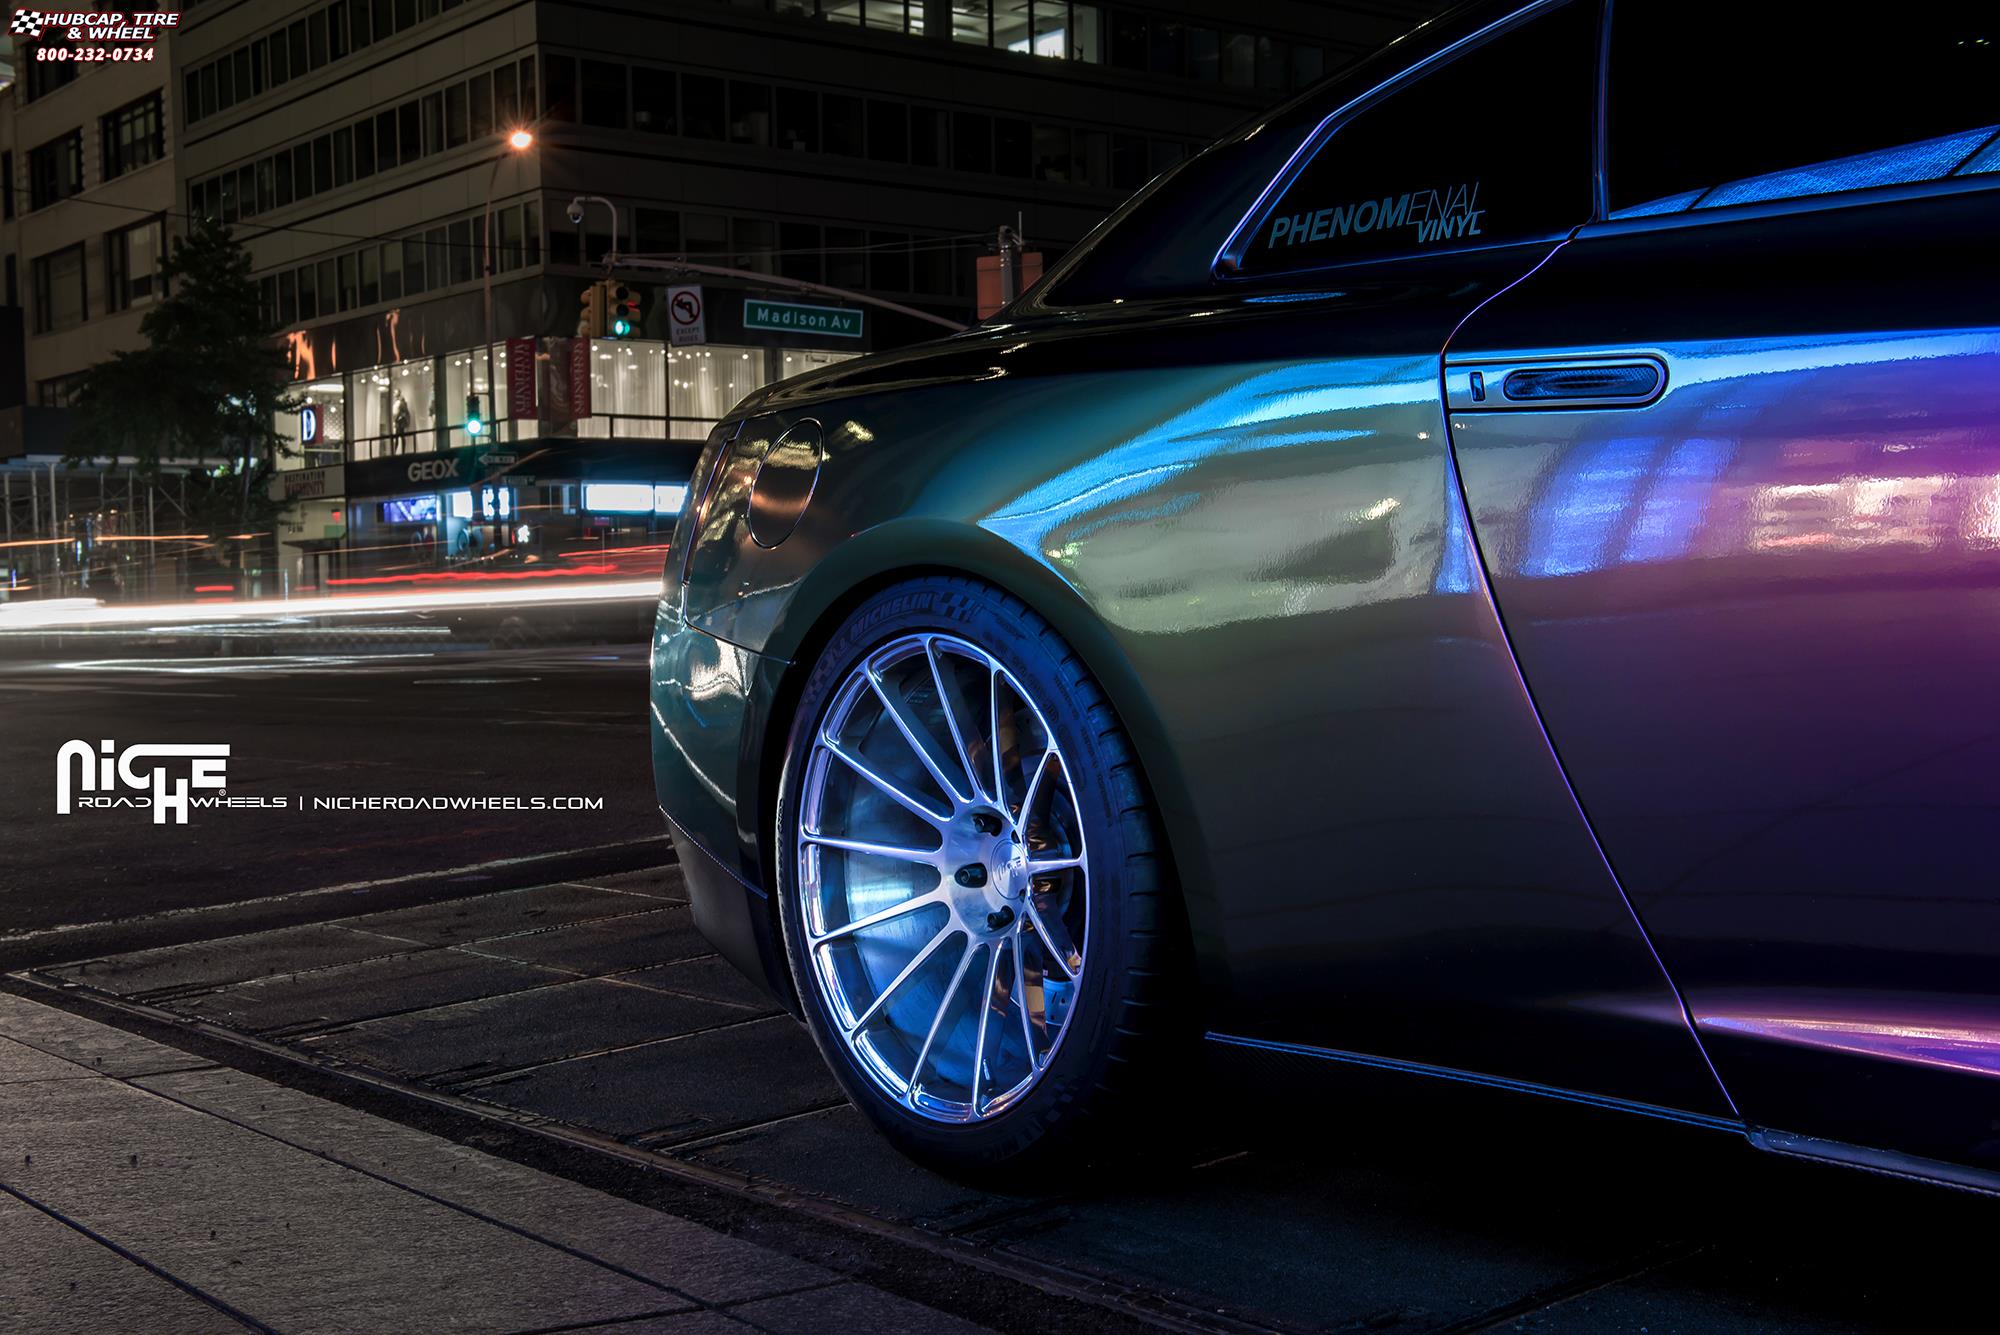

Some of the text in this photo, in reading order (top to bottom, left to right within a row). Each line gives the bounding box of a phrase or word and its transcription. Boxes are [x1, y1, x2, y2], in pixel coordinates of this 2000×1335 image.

[1268, 181, 1485, 249] PHENOMENAL
[1418, 213, 1482, 243] VINYL
[676, 327, 700, 335] EXCEPT
[757, 307, 851, 330] Madison Av
[407, 458, 460, 482] GEOX
[851, 592, 935, 635] MICHELIN
